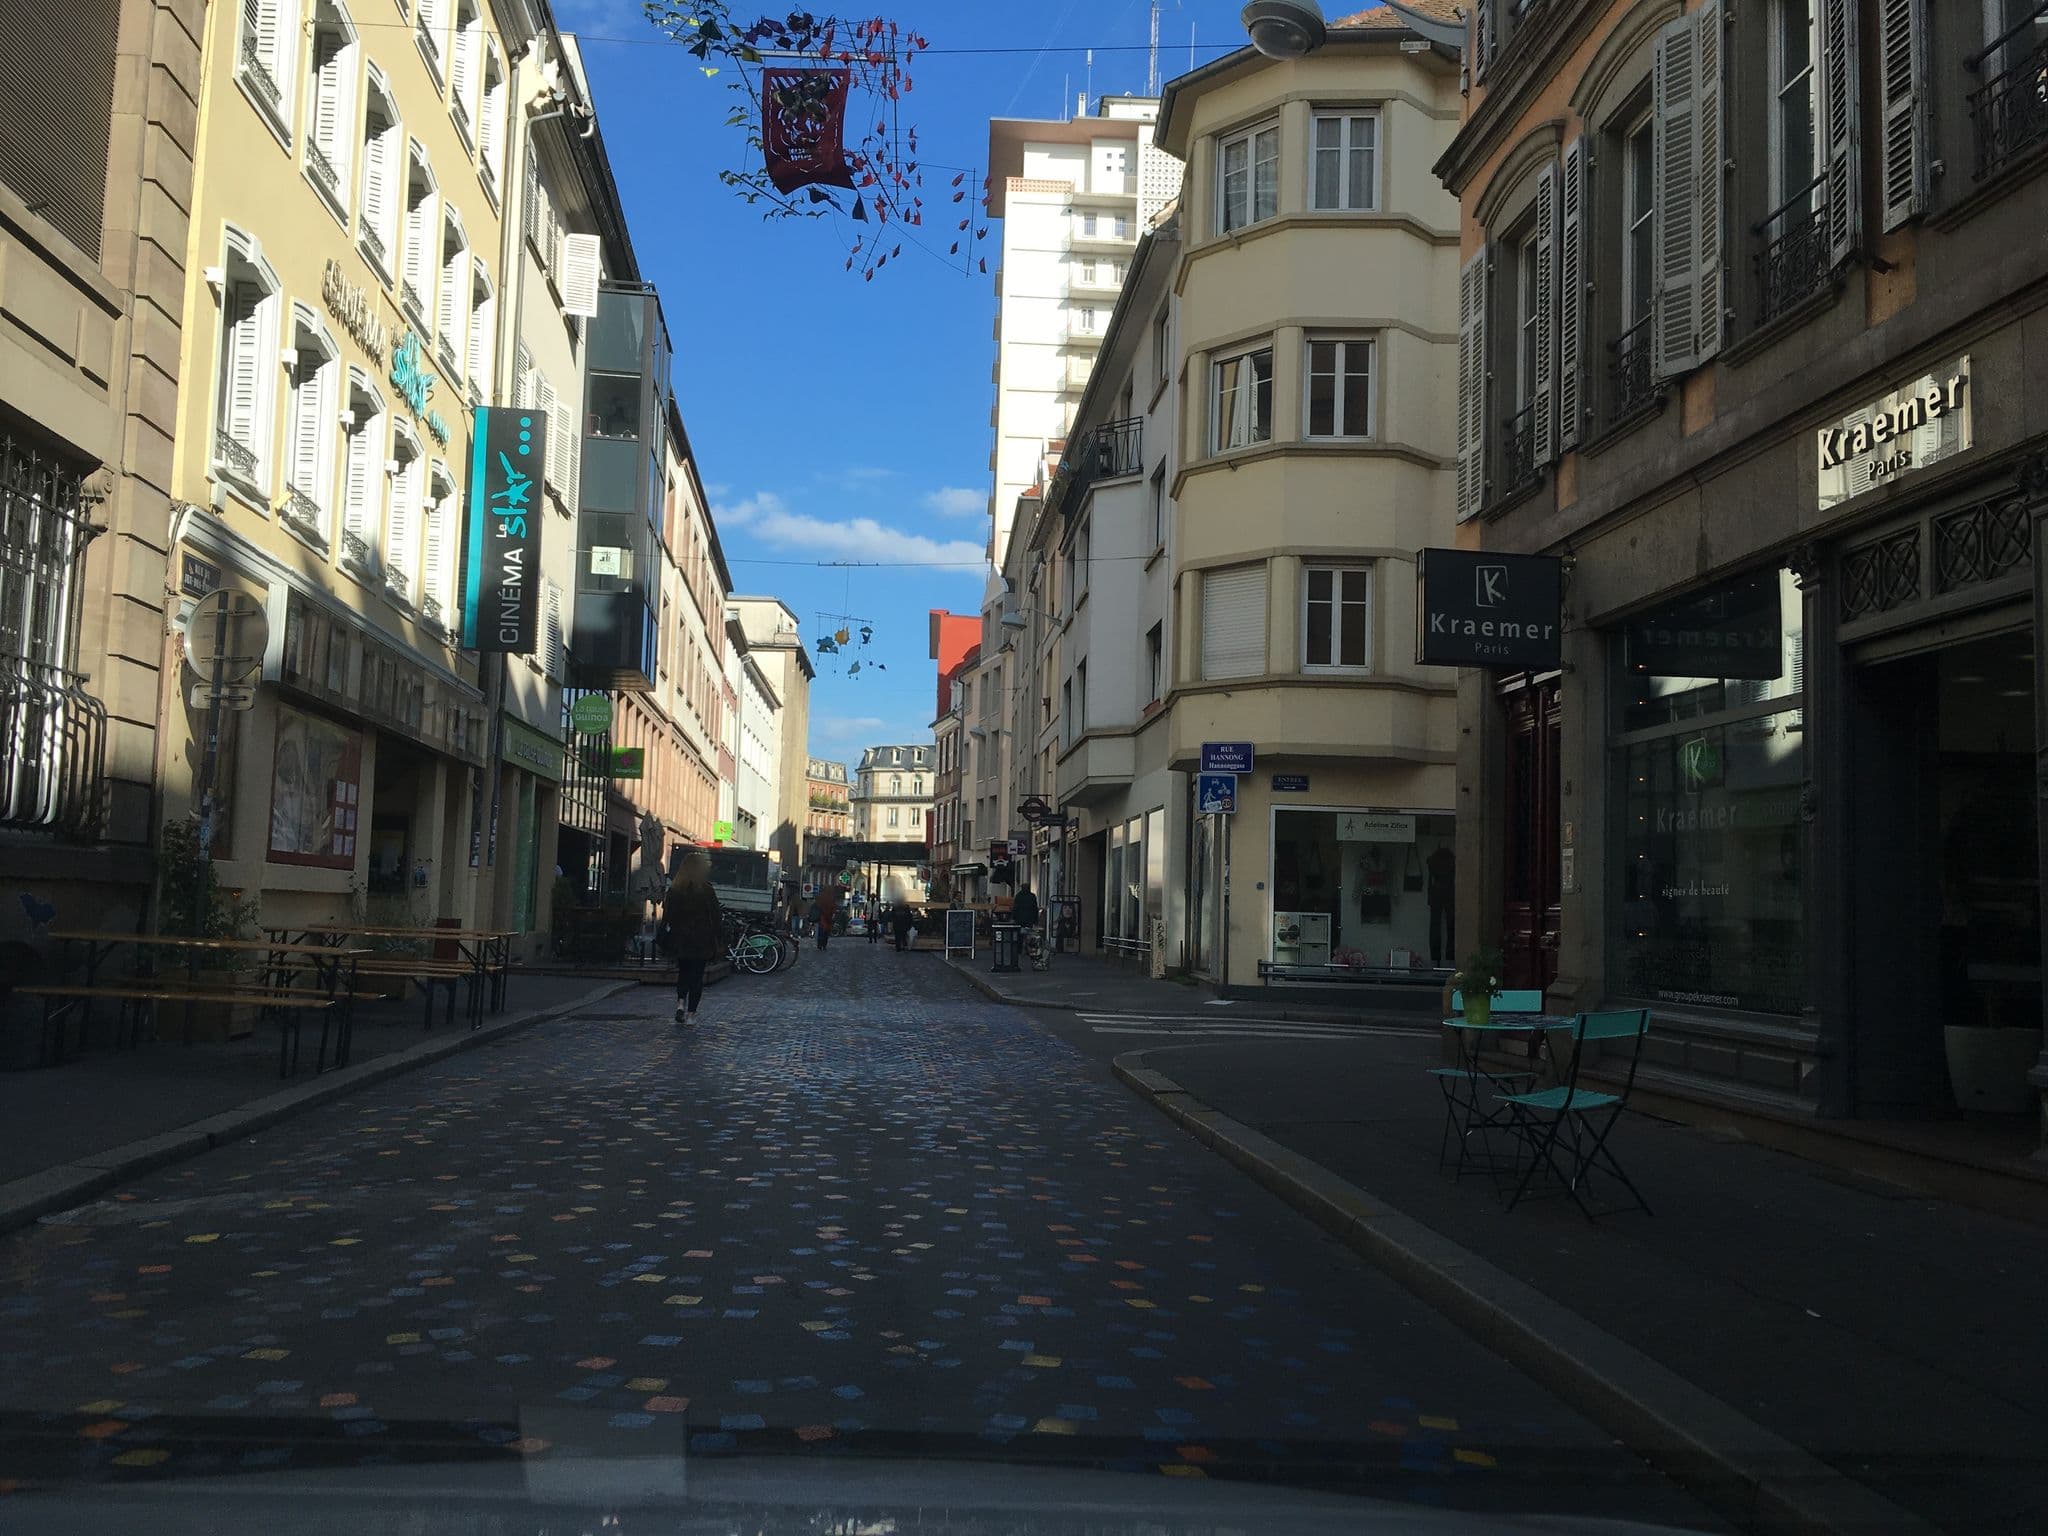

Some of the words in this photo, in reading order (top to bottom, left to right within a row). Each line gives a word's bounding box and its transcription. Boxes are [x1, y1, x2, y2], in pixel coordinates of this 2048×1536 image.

[1818, 375, 1967, 469] Kraemer
[1868, 450, 1910, 480] Paris
[498, 547, 524, 644] CINÉMA
[1483, 568, 1506, 604] K
[1431, 612, 1553, 640] Kraemer
[1475, 642, 1510, 655] Paris
[1656, 805, 1737, 833] Kraemer
[1688, 880, 1698, 896] de
[1700, 880, 1729, 896] beauté
